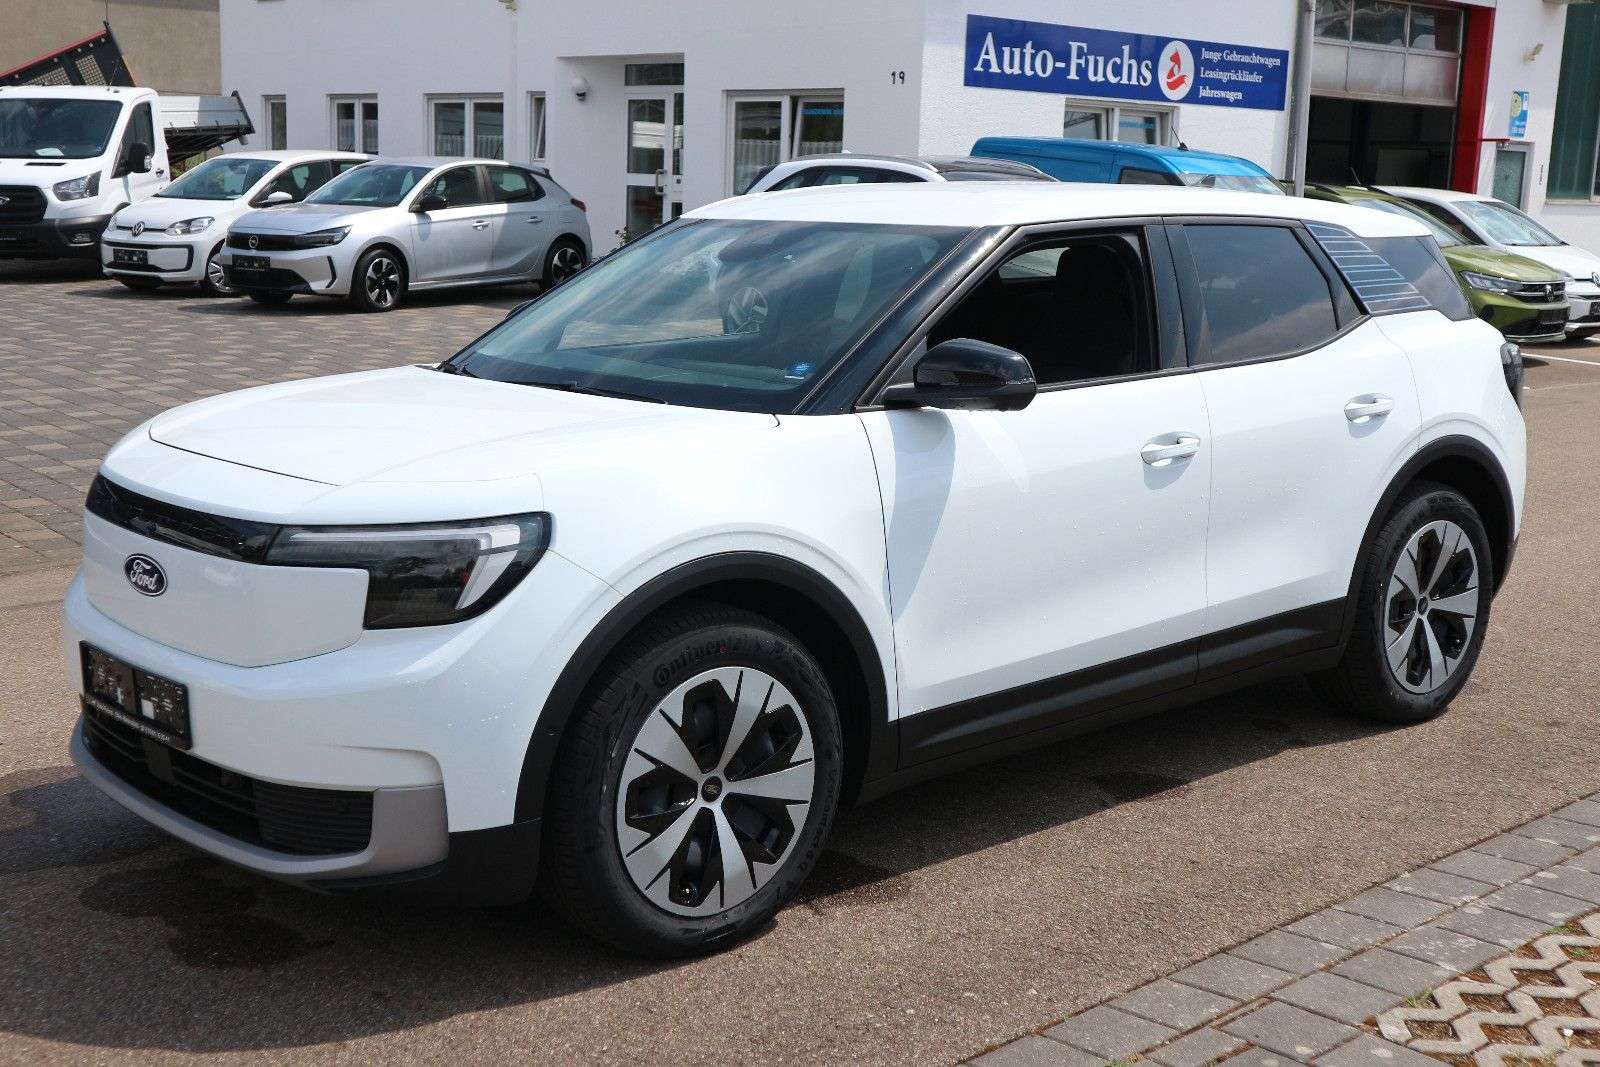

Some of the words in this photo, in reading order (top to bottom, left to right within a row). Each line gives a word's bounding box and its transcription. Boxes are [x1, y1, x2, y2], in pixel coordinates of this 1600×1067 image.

[973, 31, 1153, 88] Auto-Fuchs
[1201, 47, 1222, 63] Junge
[1223, 49, 1281, 68] Gebrauchtwagen
[890, 70, 905, 84] 19
[1200, 67, 1264, 83] Leasingrückläufer
[1198, 85, 1243, 102] Jahreswagen
[129, 559, 158, 591] Ford
